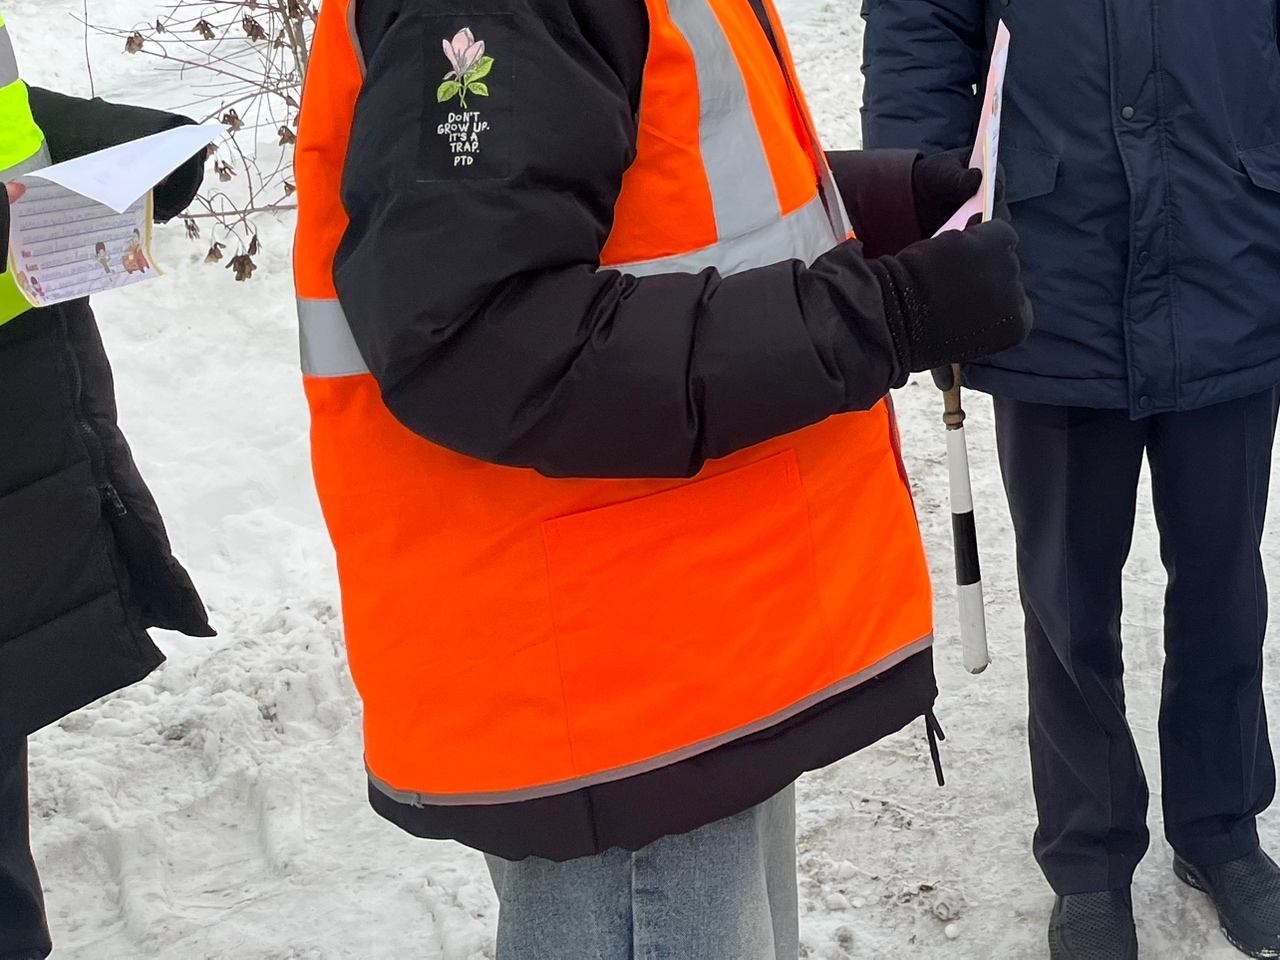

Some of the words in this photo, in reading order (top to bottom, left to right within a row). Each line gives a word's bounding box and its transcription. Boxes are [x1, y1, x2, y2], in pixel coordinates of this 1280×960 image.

[448, 112, 480, 123] DON'T
[437, 123, 470, 134] GROW
[473, 122, 490, 133] UP.
[449, 132, 467, 142] IT'S
[470, 131, 478, 142] A
[450, 142, 480, 152] TRAP.
[454, 156, 474, 166] PTD
